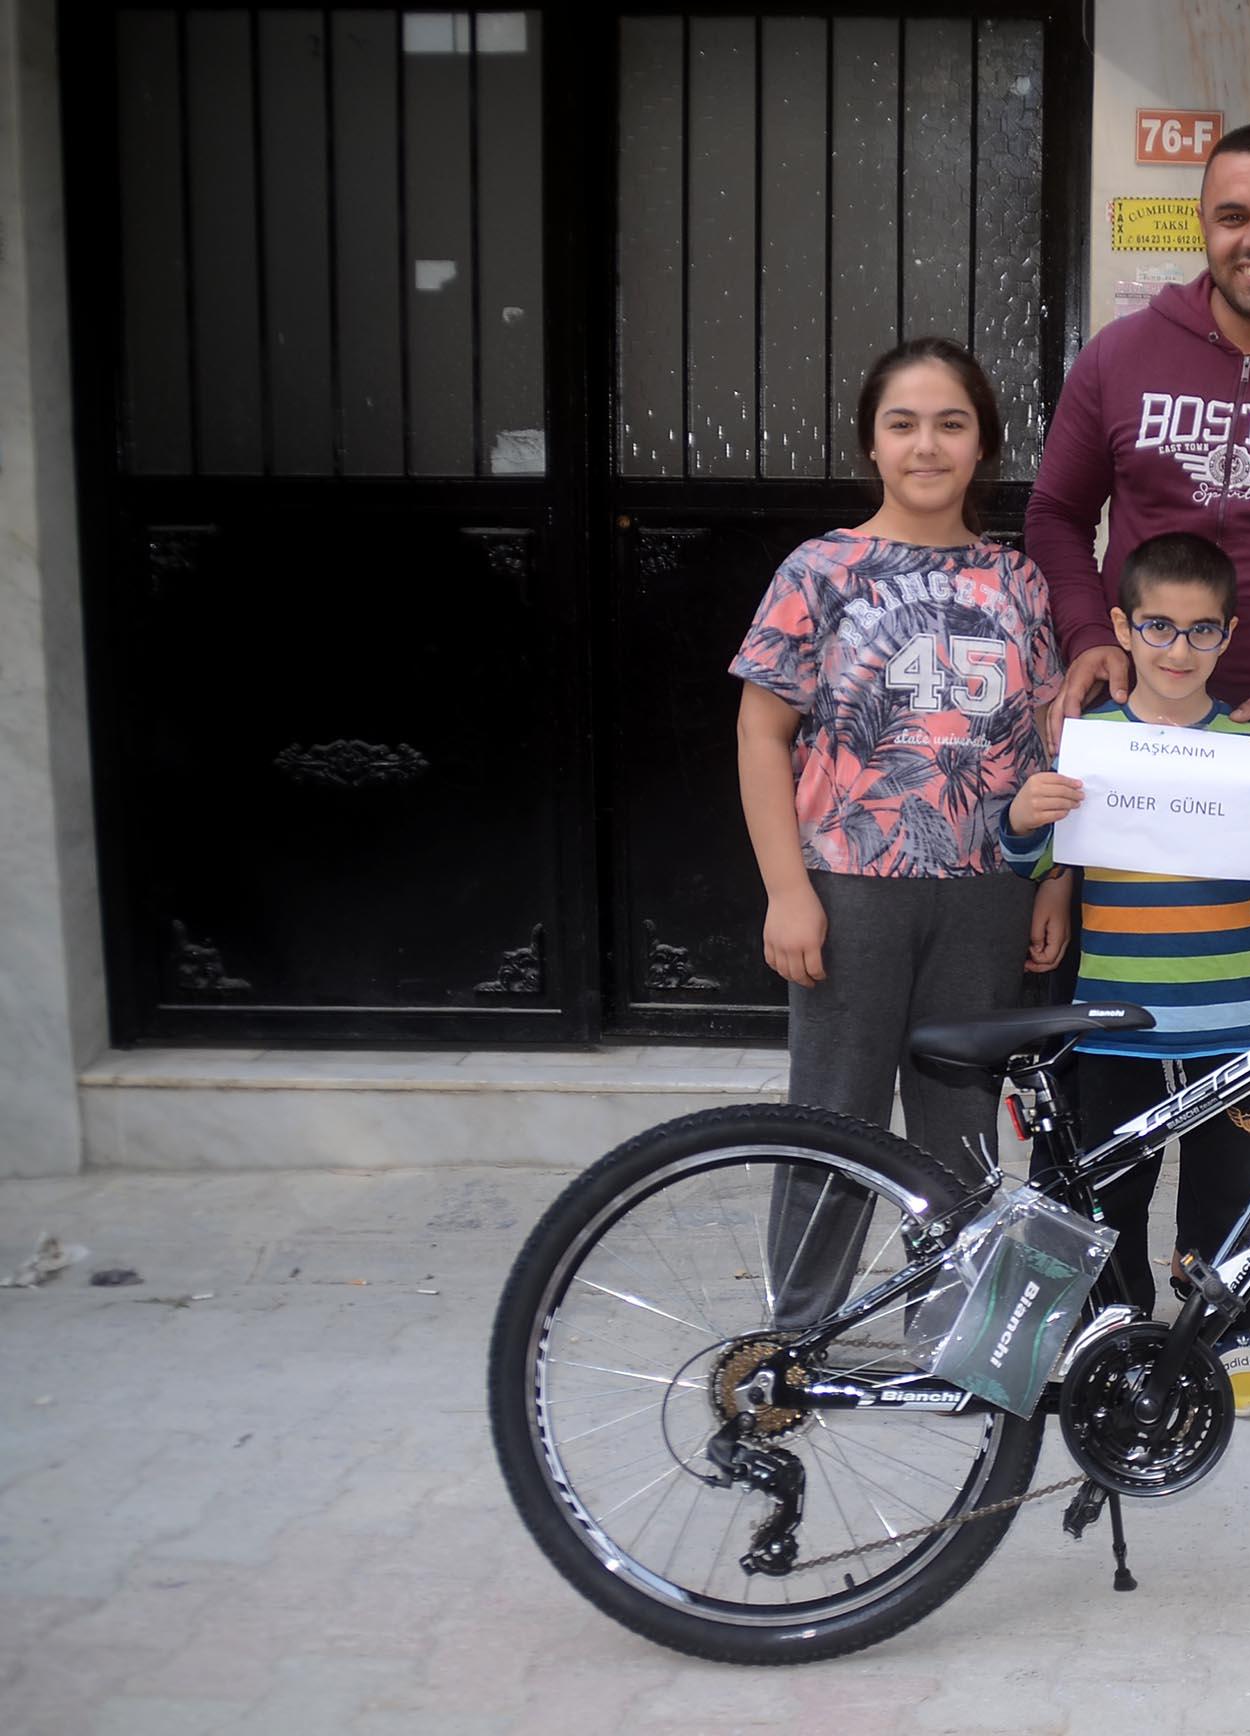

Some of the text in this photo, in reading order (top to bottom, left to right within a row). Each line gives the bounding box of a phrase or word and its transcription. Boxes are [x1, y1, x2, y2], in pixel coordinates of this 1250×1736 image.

[1141, 118, 1214, 154] 76-F
[1128, 204, 1197, 222] CUMHURİY
[1154, 220, 1189, 230] TAKSİ
[1158, 442, 1209, 454] EAST TOWN
[885, 633, 1006, 716] 45
[893, 728, 929, 744] state
[1130, 740, 1215, 759] BAŞKANIM
[1106, 790, 1225, 817] ÖMER GÜNEL
[1088, 1009, 1125, 1017] Bianchi
[1167, 1106, 1200, 1130] BIANCHI
[990, 1280, 1040, 1369] Bianchi
[880, 1390, 962, 1403] Bianchi
